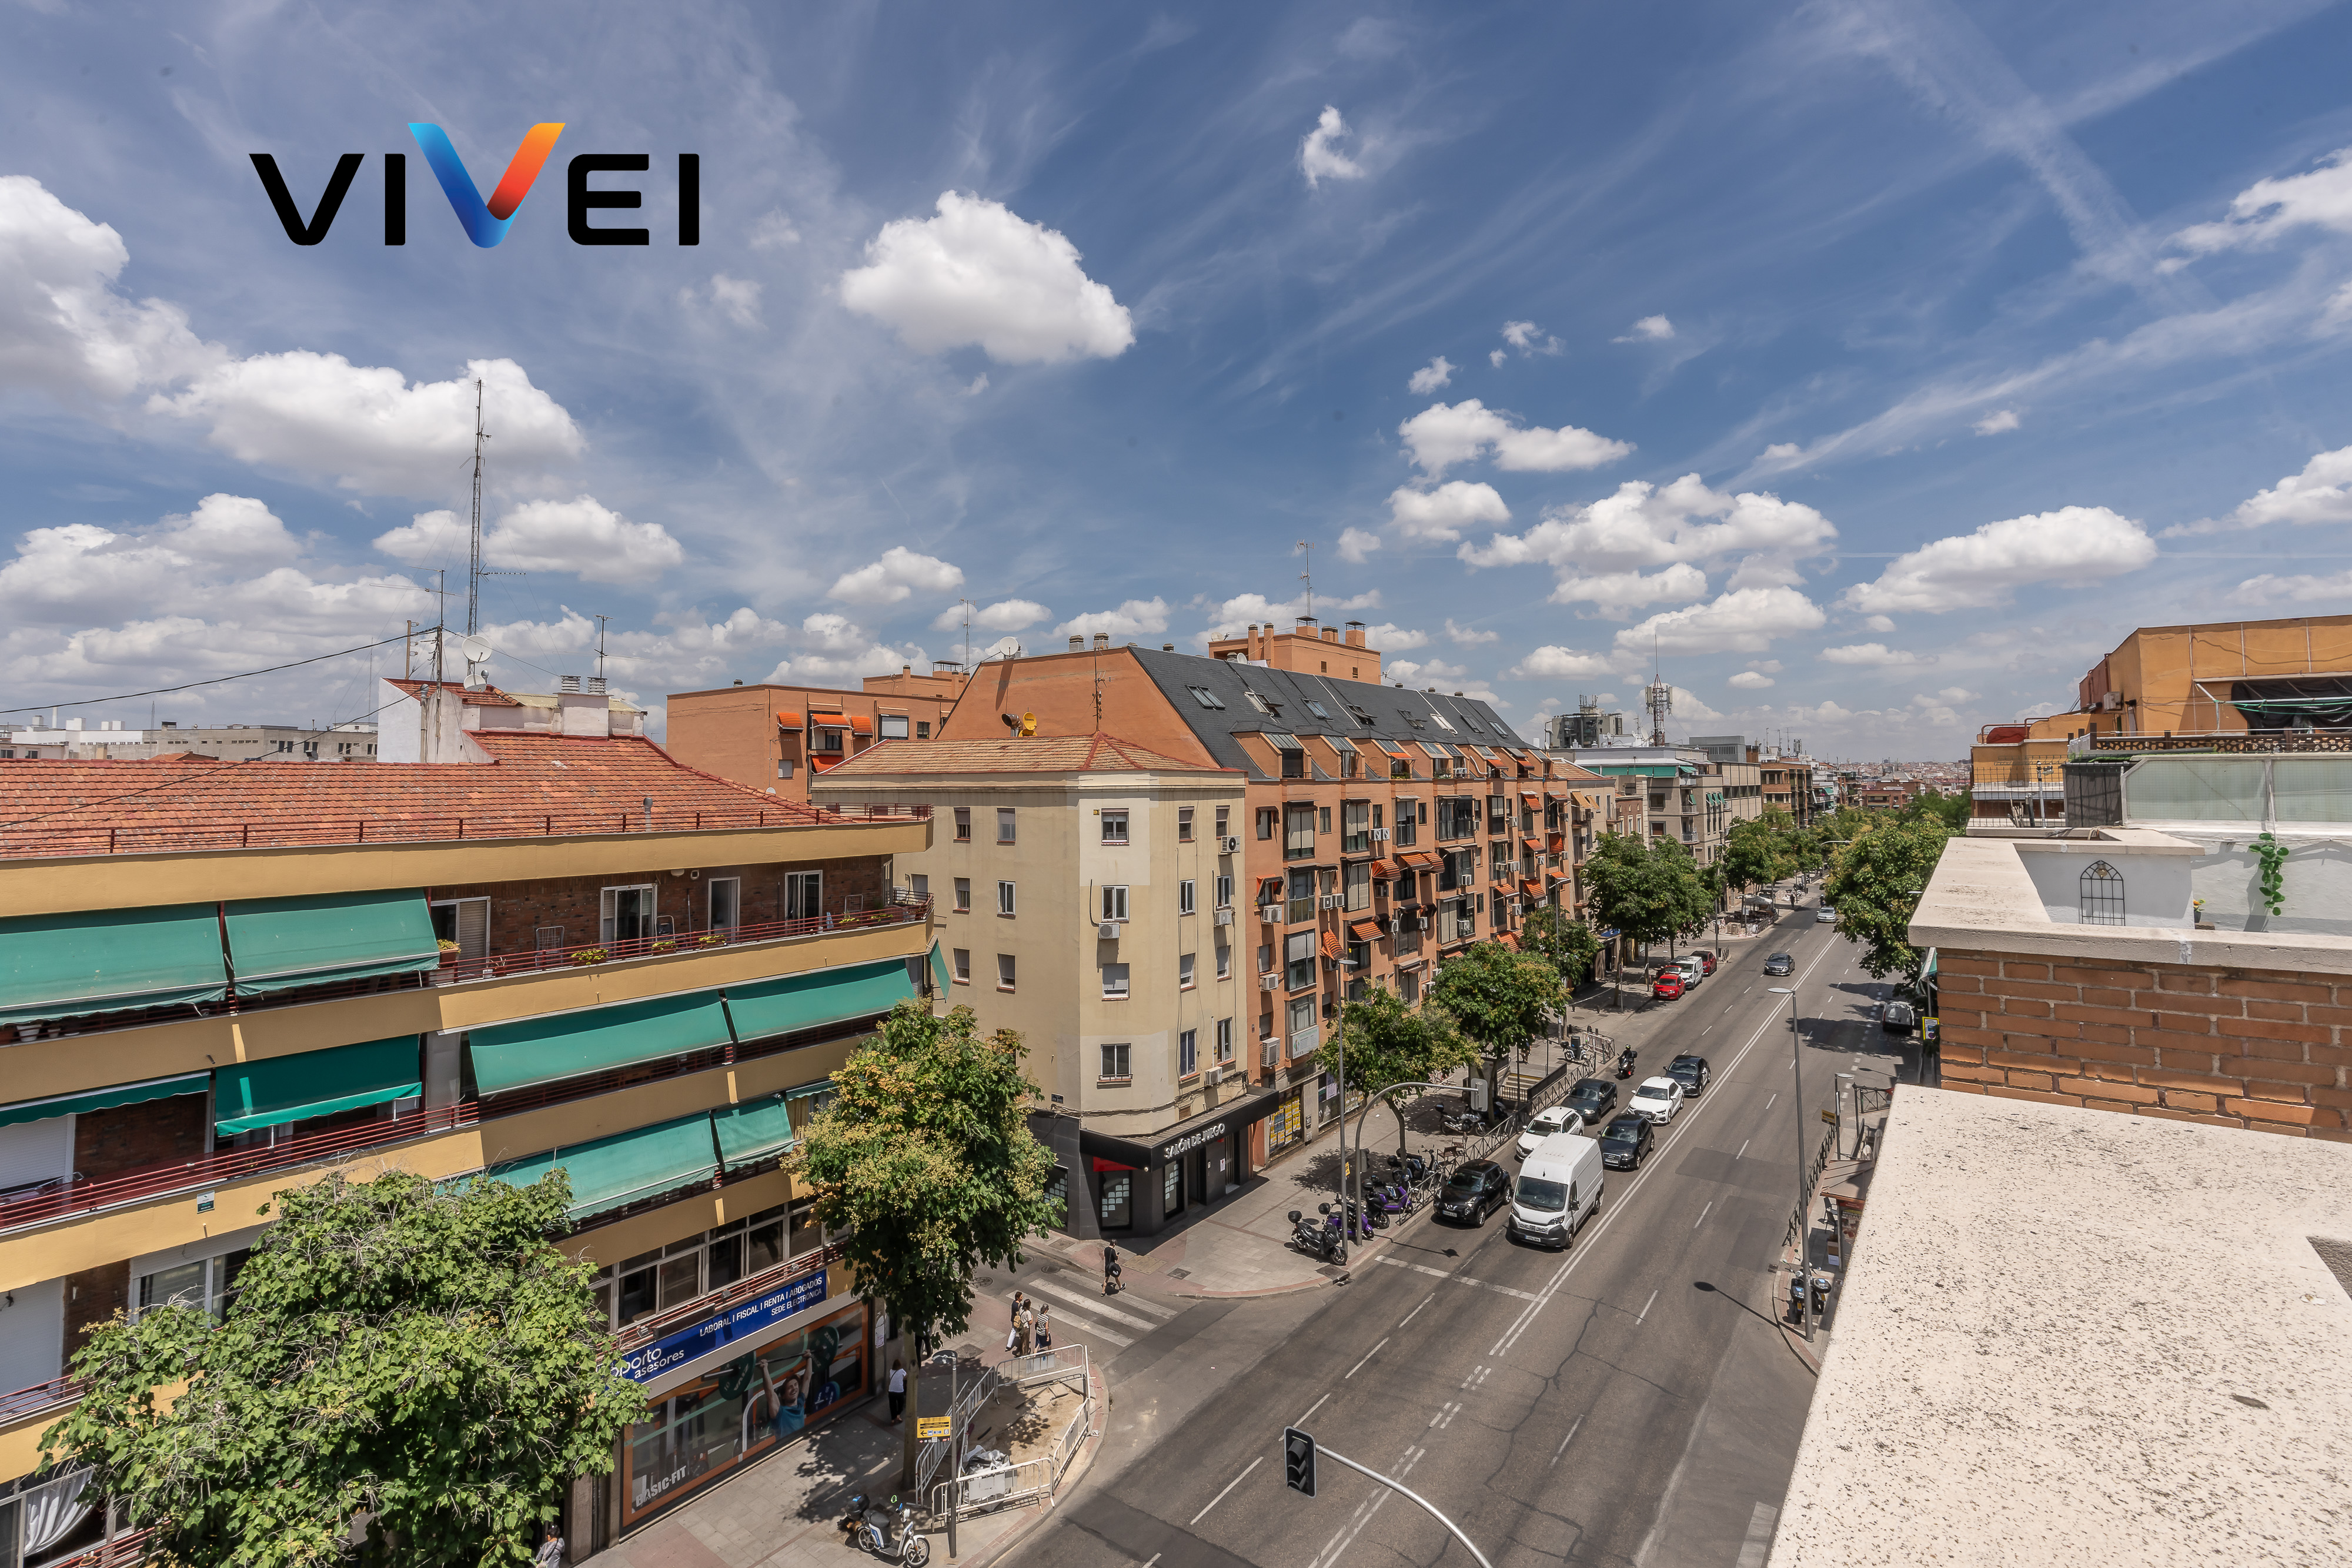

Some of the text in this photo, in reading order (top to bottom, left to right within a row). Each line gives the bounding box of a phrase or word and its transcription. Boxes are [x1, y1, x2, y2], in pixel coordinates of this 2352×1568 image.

[1164, 1123, 1225, 1159] SALÓN DE JUEGO
[700, 1317, 731, 1337] LABORAL
[736, 1305, 759, 1321] FISCAL
[764, 1293, 785, 1309] RENTA
[789, 1276, 823, 1298] ABOGADOS
[771, 1288, 822, 1316] SEDE ELECTRÓNICA
[634, 1350, 684, 1379] asesores
